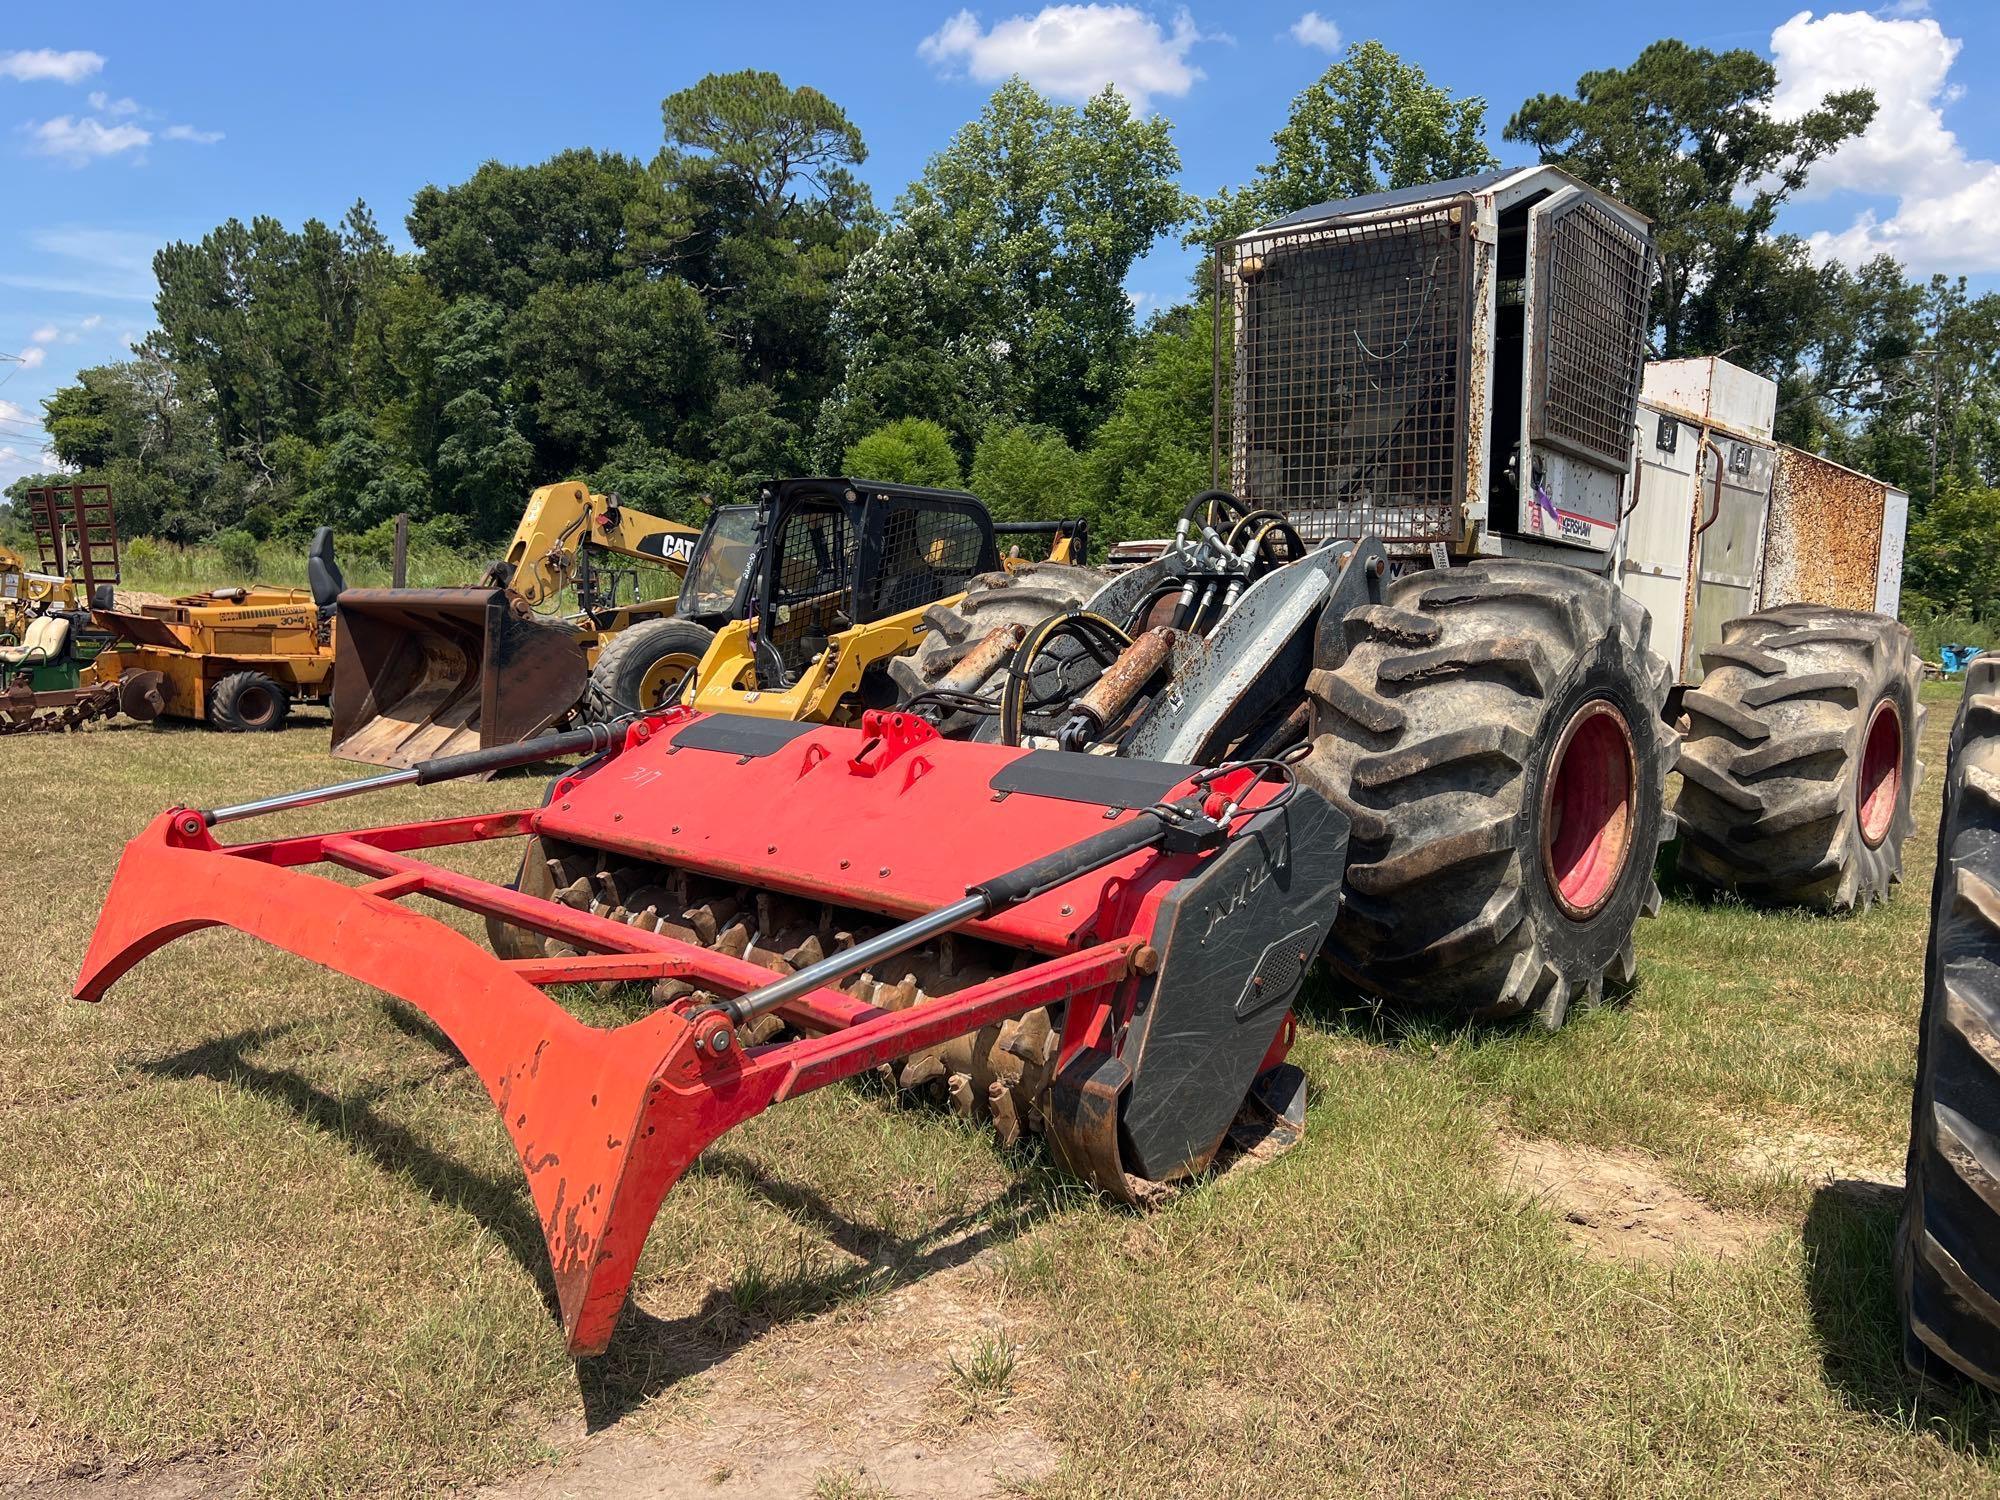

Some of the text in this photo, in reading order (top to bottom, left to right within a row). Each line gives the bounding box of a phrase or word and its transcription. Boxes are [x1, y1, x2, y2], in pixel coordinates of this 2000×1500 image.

[1562, 518, 1592, 538] KERSHAW
[661, 534, 696, 562] CAT
[620, 766, 663, 790] 317
